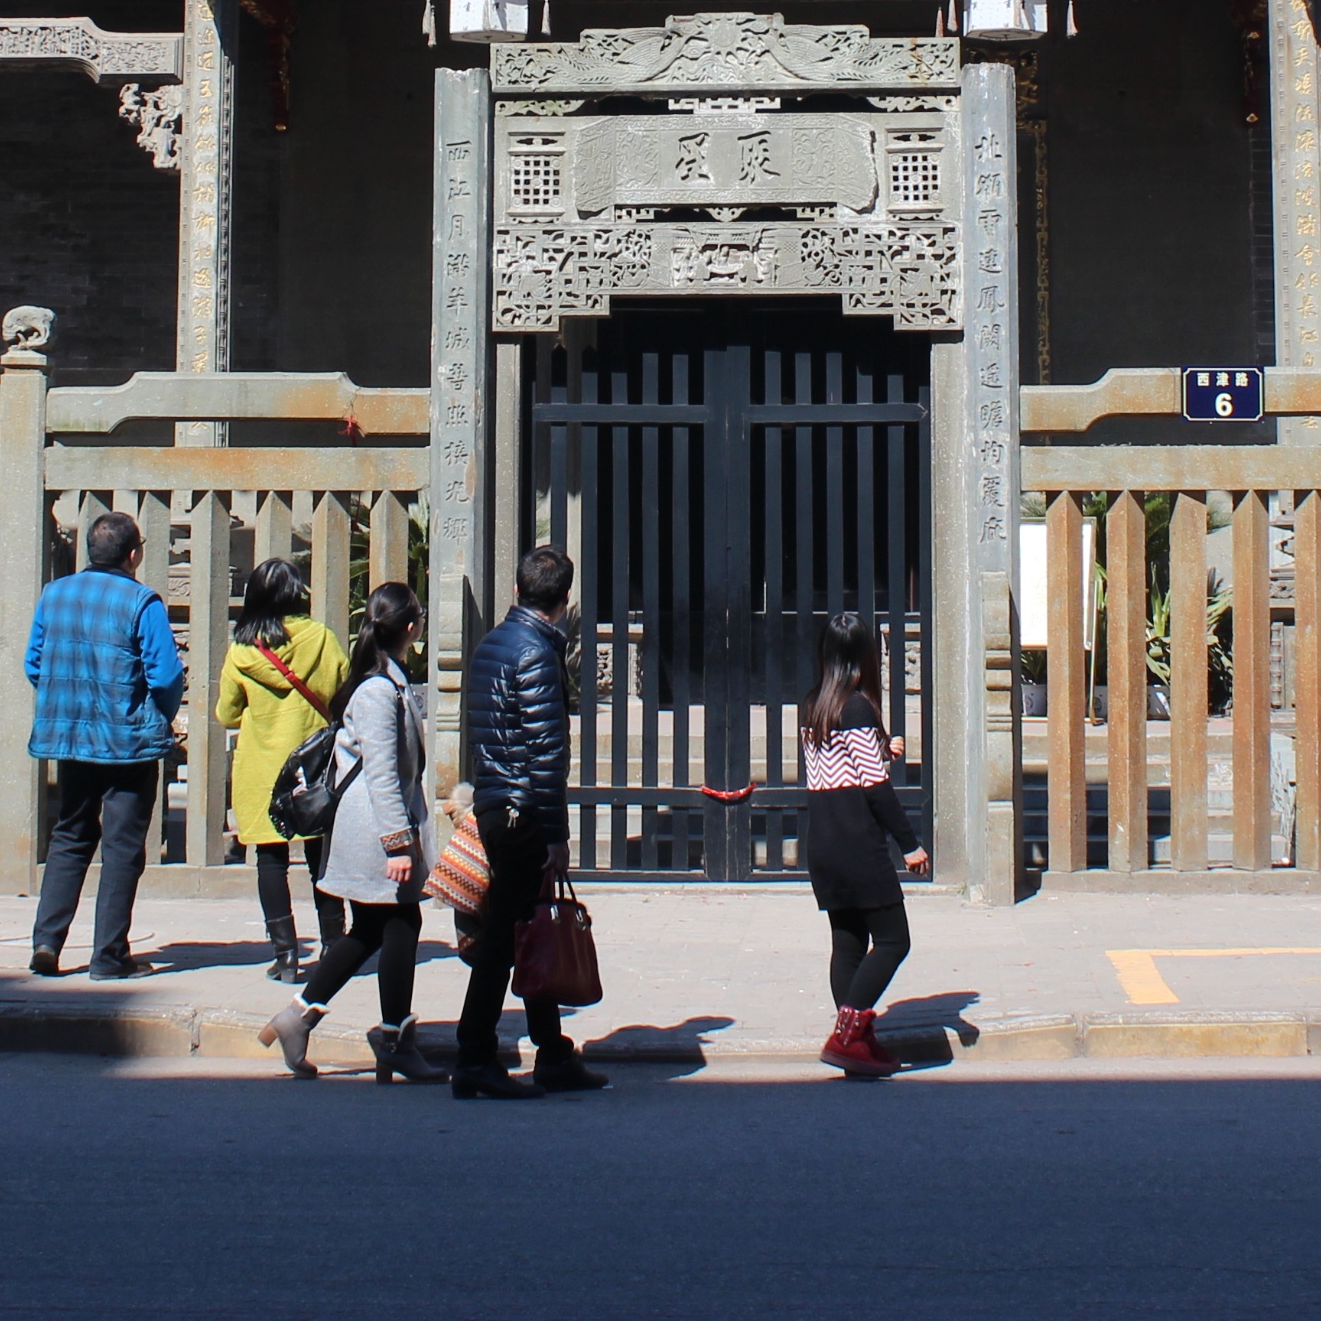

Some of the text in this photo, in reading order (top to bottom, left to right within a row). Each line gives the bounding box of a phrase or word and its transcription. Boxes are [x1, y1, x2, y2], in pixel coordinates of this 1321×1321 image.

[1197, 372, 1249, 387] 西津路
[1214, 393, 1234, 417] 6
